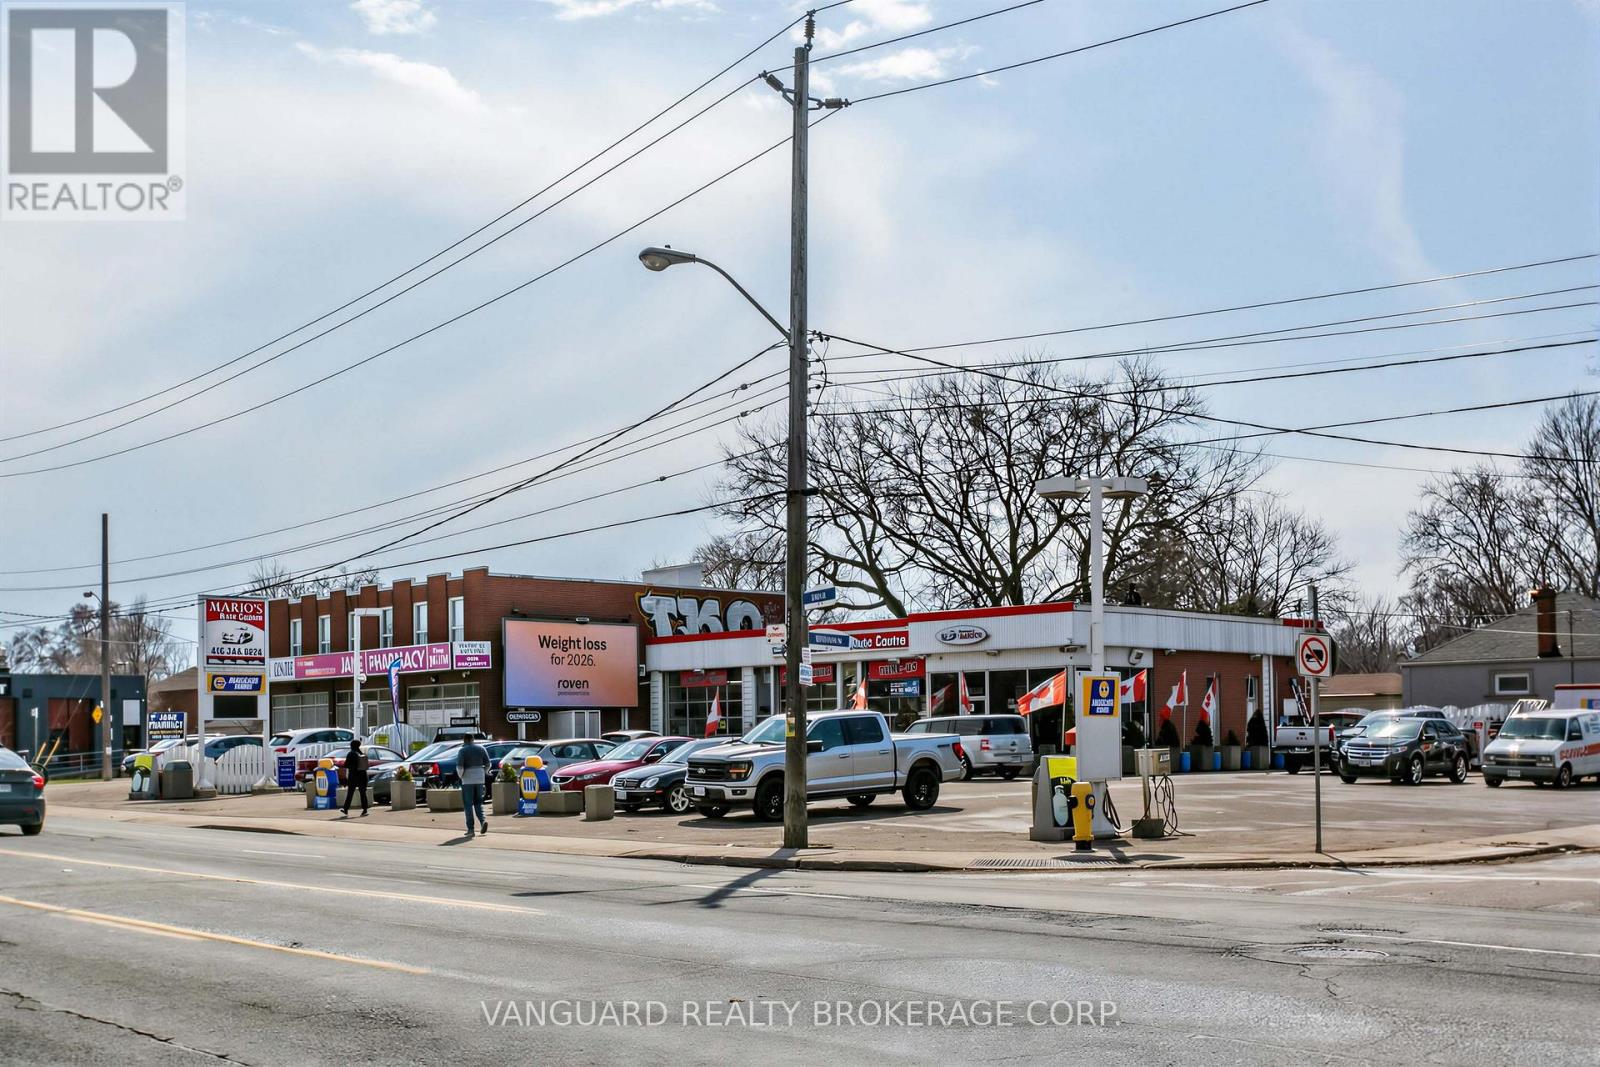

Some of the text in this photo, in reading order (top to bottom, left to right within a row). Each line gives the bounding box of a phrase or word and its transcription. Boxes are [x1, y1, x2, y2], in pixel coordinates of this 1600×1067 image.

[209, 601, 263, 614] MARIO'S
[538, 635, 607, 652] Weight loss
[550, 653, 596, 667] for 2026.
[557, 679, 590, 689] roven
